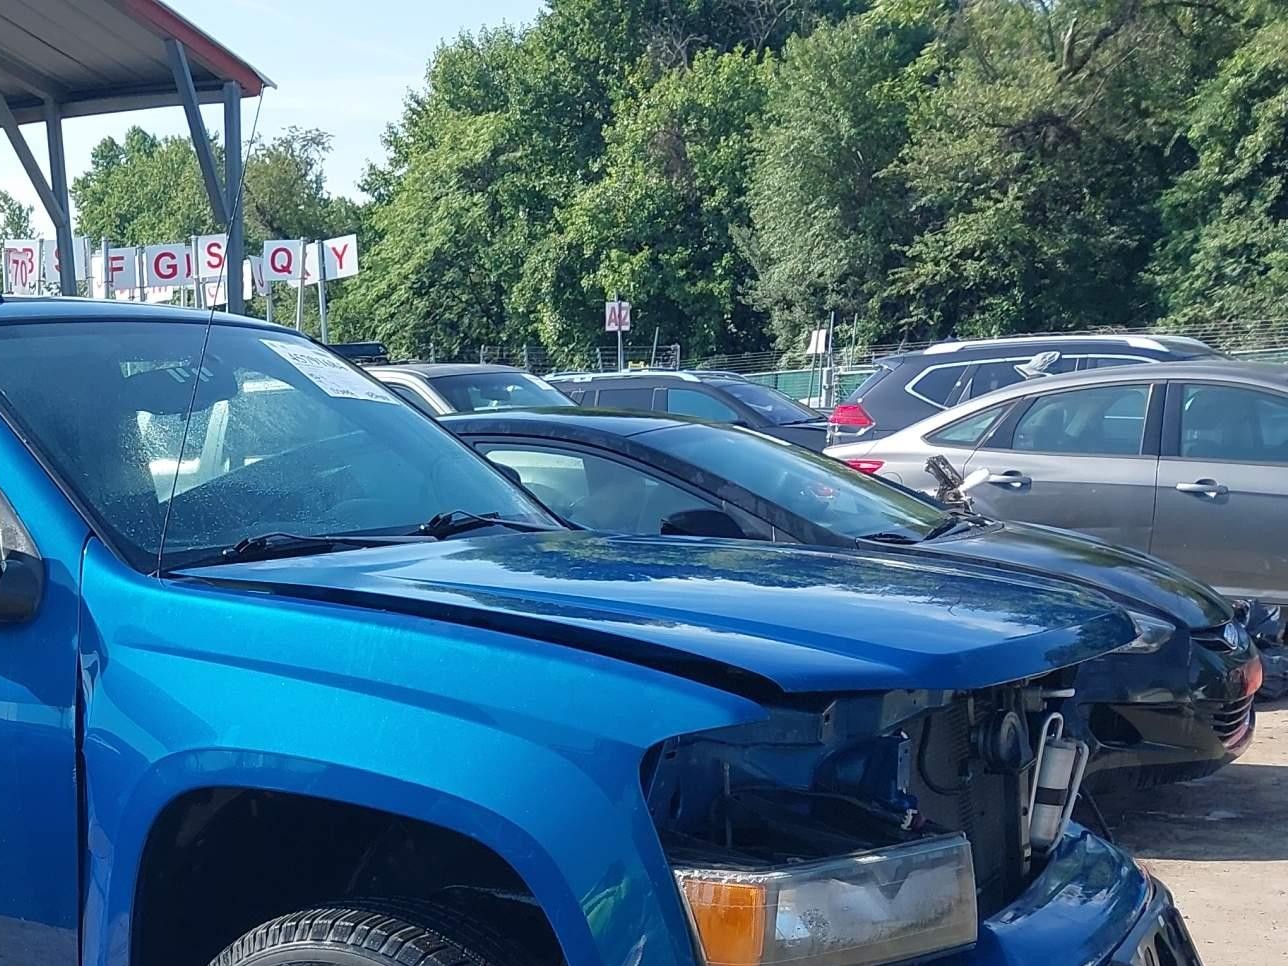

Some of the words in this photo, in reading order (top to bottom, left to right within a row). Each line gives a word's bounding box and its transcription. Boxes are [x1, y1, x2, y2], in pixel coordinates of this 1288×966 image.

[153, 251, 178, 279] G
[206, 242, 224, 269] S
[270, 247, 292, 275] Q
[331, 243, 348, 270] Y
[13, 258, 29, 288] 70
